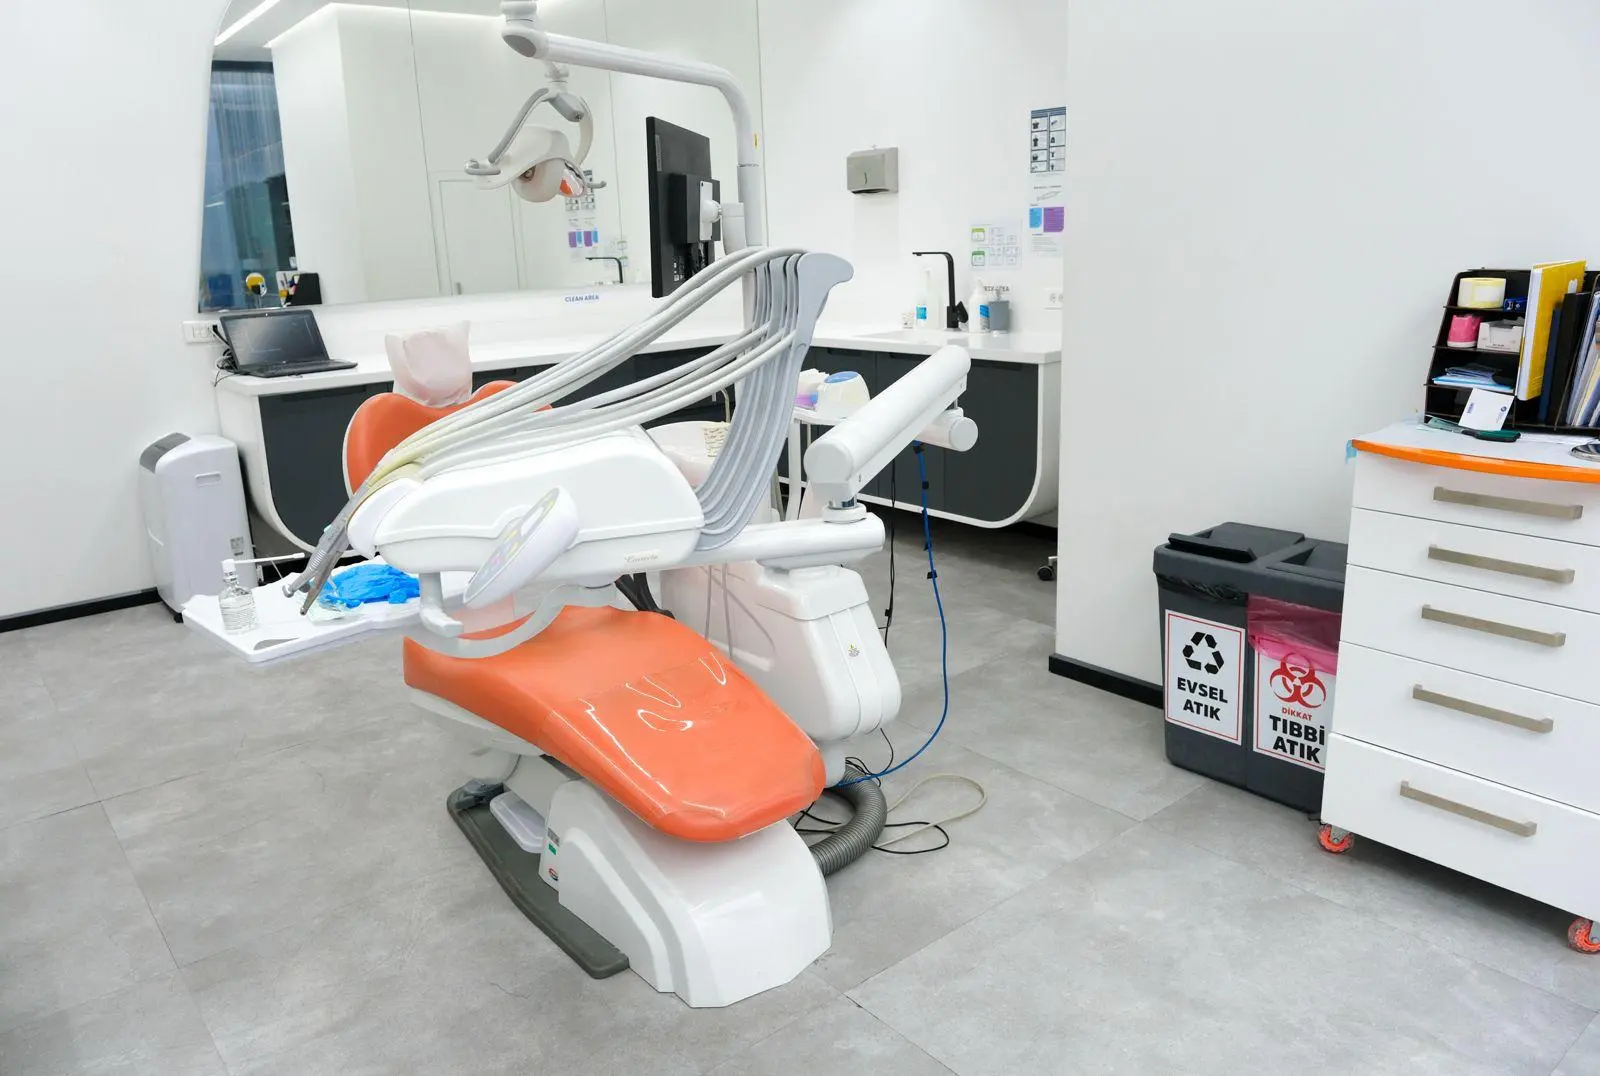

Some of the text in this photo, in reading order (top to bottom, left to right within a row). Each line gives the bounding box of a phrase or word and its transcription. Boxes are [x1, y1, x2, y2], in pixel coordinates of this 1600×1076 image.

[1177, 677, 1228, 704] EVSEL
[1183, 699, 1221, 722] ATIK
[1281, 706, 1313, 722] DİKKAT
[1269, 715, 1325, 746] TIBBİ
[1272, 736, 1321, 764] ATIK
